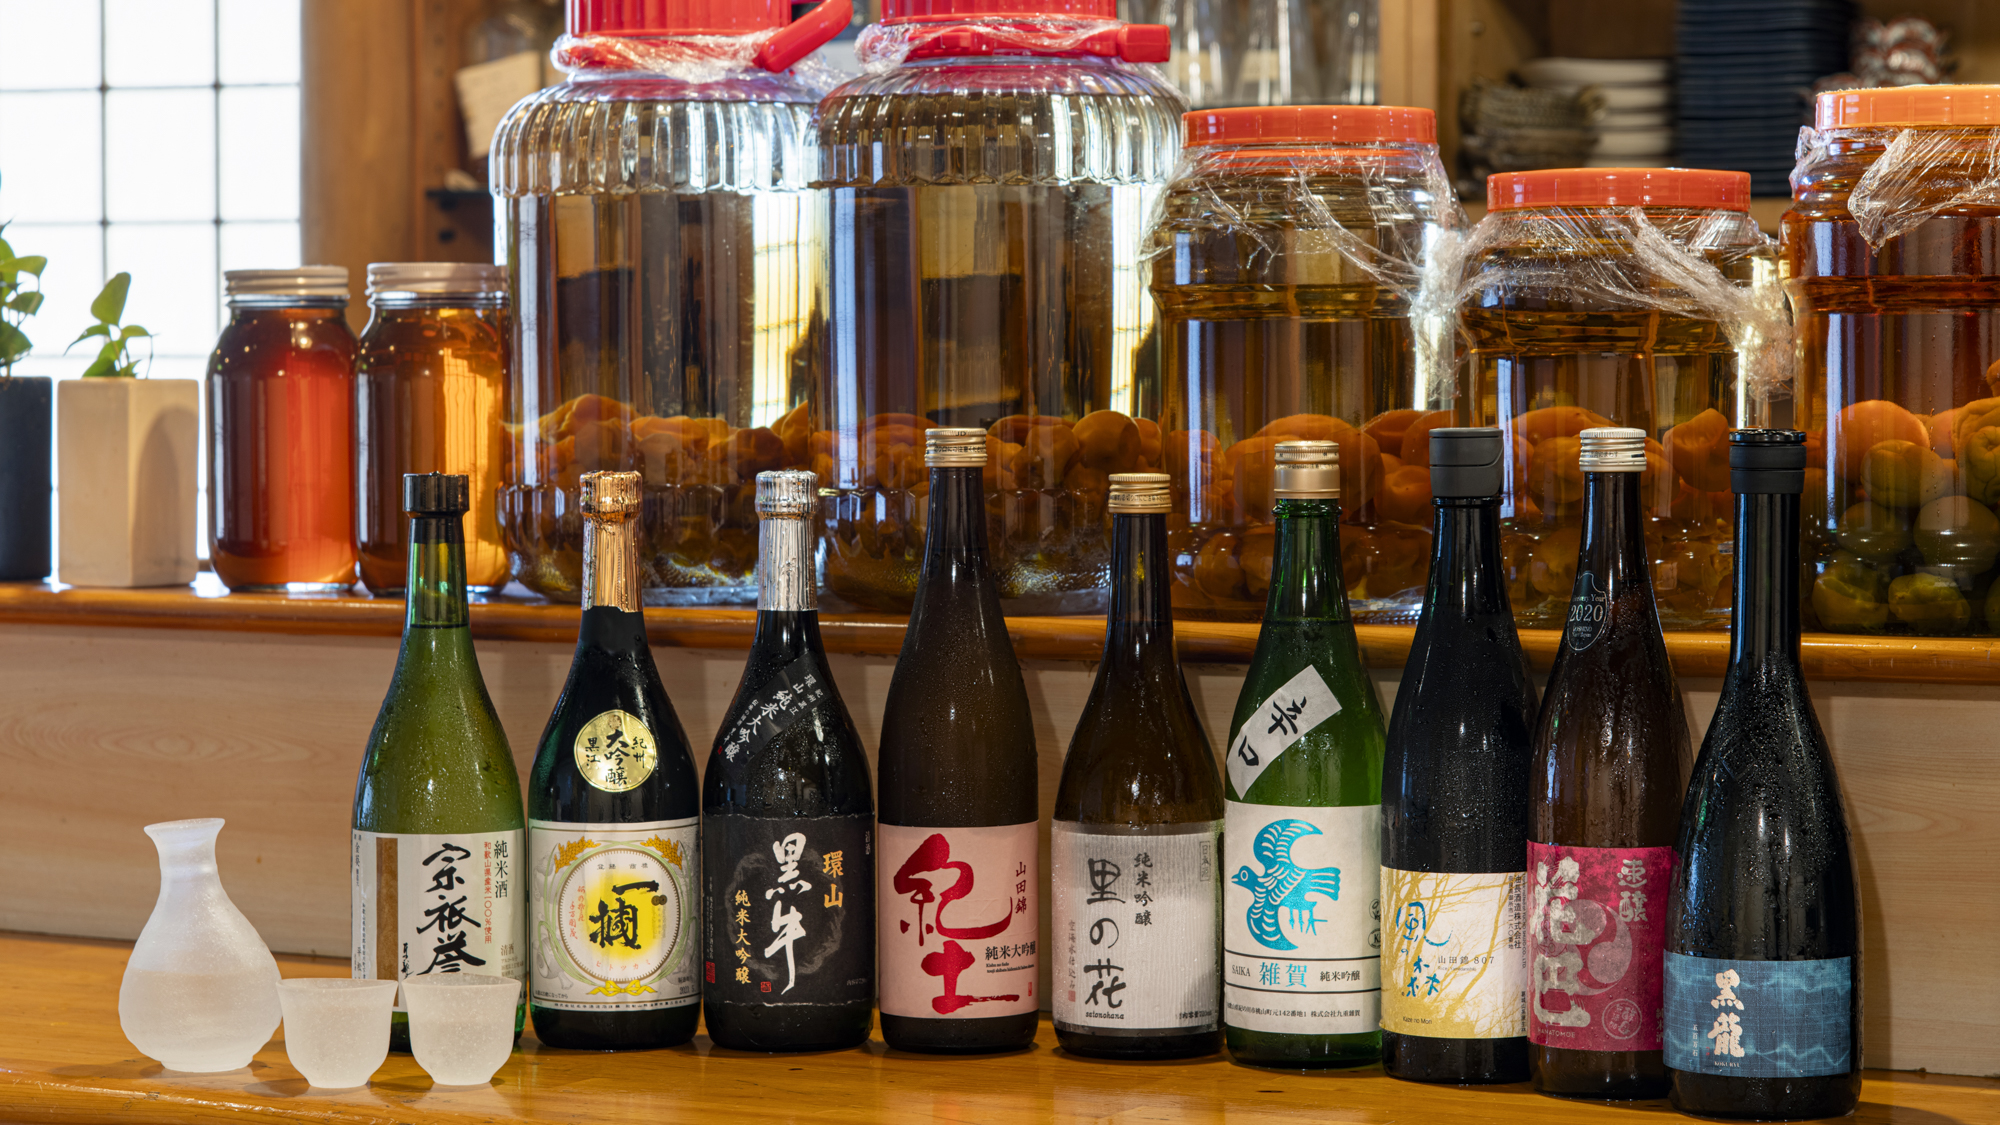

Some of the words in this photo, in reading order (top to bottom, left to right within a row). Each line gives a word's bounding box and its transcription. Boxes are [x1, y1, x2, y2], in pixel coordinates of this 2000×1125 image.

[1569, 604, 1604, 622] 2020
[585, 736, 601, 767] 黒江
[631, 736, 648, 769] 紀州
[724, 689, 793, 763] 純米大吟醸
[1238, 696, 1307, 766] 辛口
[603, 728, 631, 786] 大吟醸
[493, 839, 509, 899] 純米酒
[822, 850, 844, 908] 環山
[1014, 861, 1027, 915] 山田錦
[1133, 852, 1154, 926] 純米吟醸
[1616, 859, 1648, 922] 速醸
[735, 889, 752, 984] 純米大吟醸
[764, 832, 813, 996] 黒牛
[893, 833, 1020, 1015] 紀土
[1083, 858, 1126, 1008] 里の花
[1231, 965, 1251, 977] SAIKA
[1258, 961, 1308, 988] 雑賀
[1319, 970, 1361, 982] 純米吟醸
[1395, 901, 1454, 997] 風の森
[1438, 955, 1469, 964] 山田錦
[1473, 956, 1495, 965] 807
[1085, 1010, 1125, 1020] satonohana
[1537, 1027, 1576, 1039] HANATOMOE
